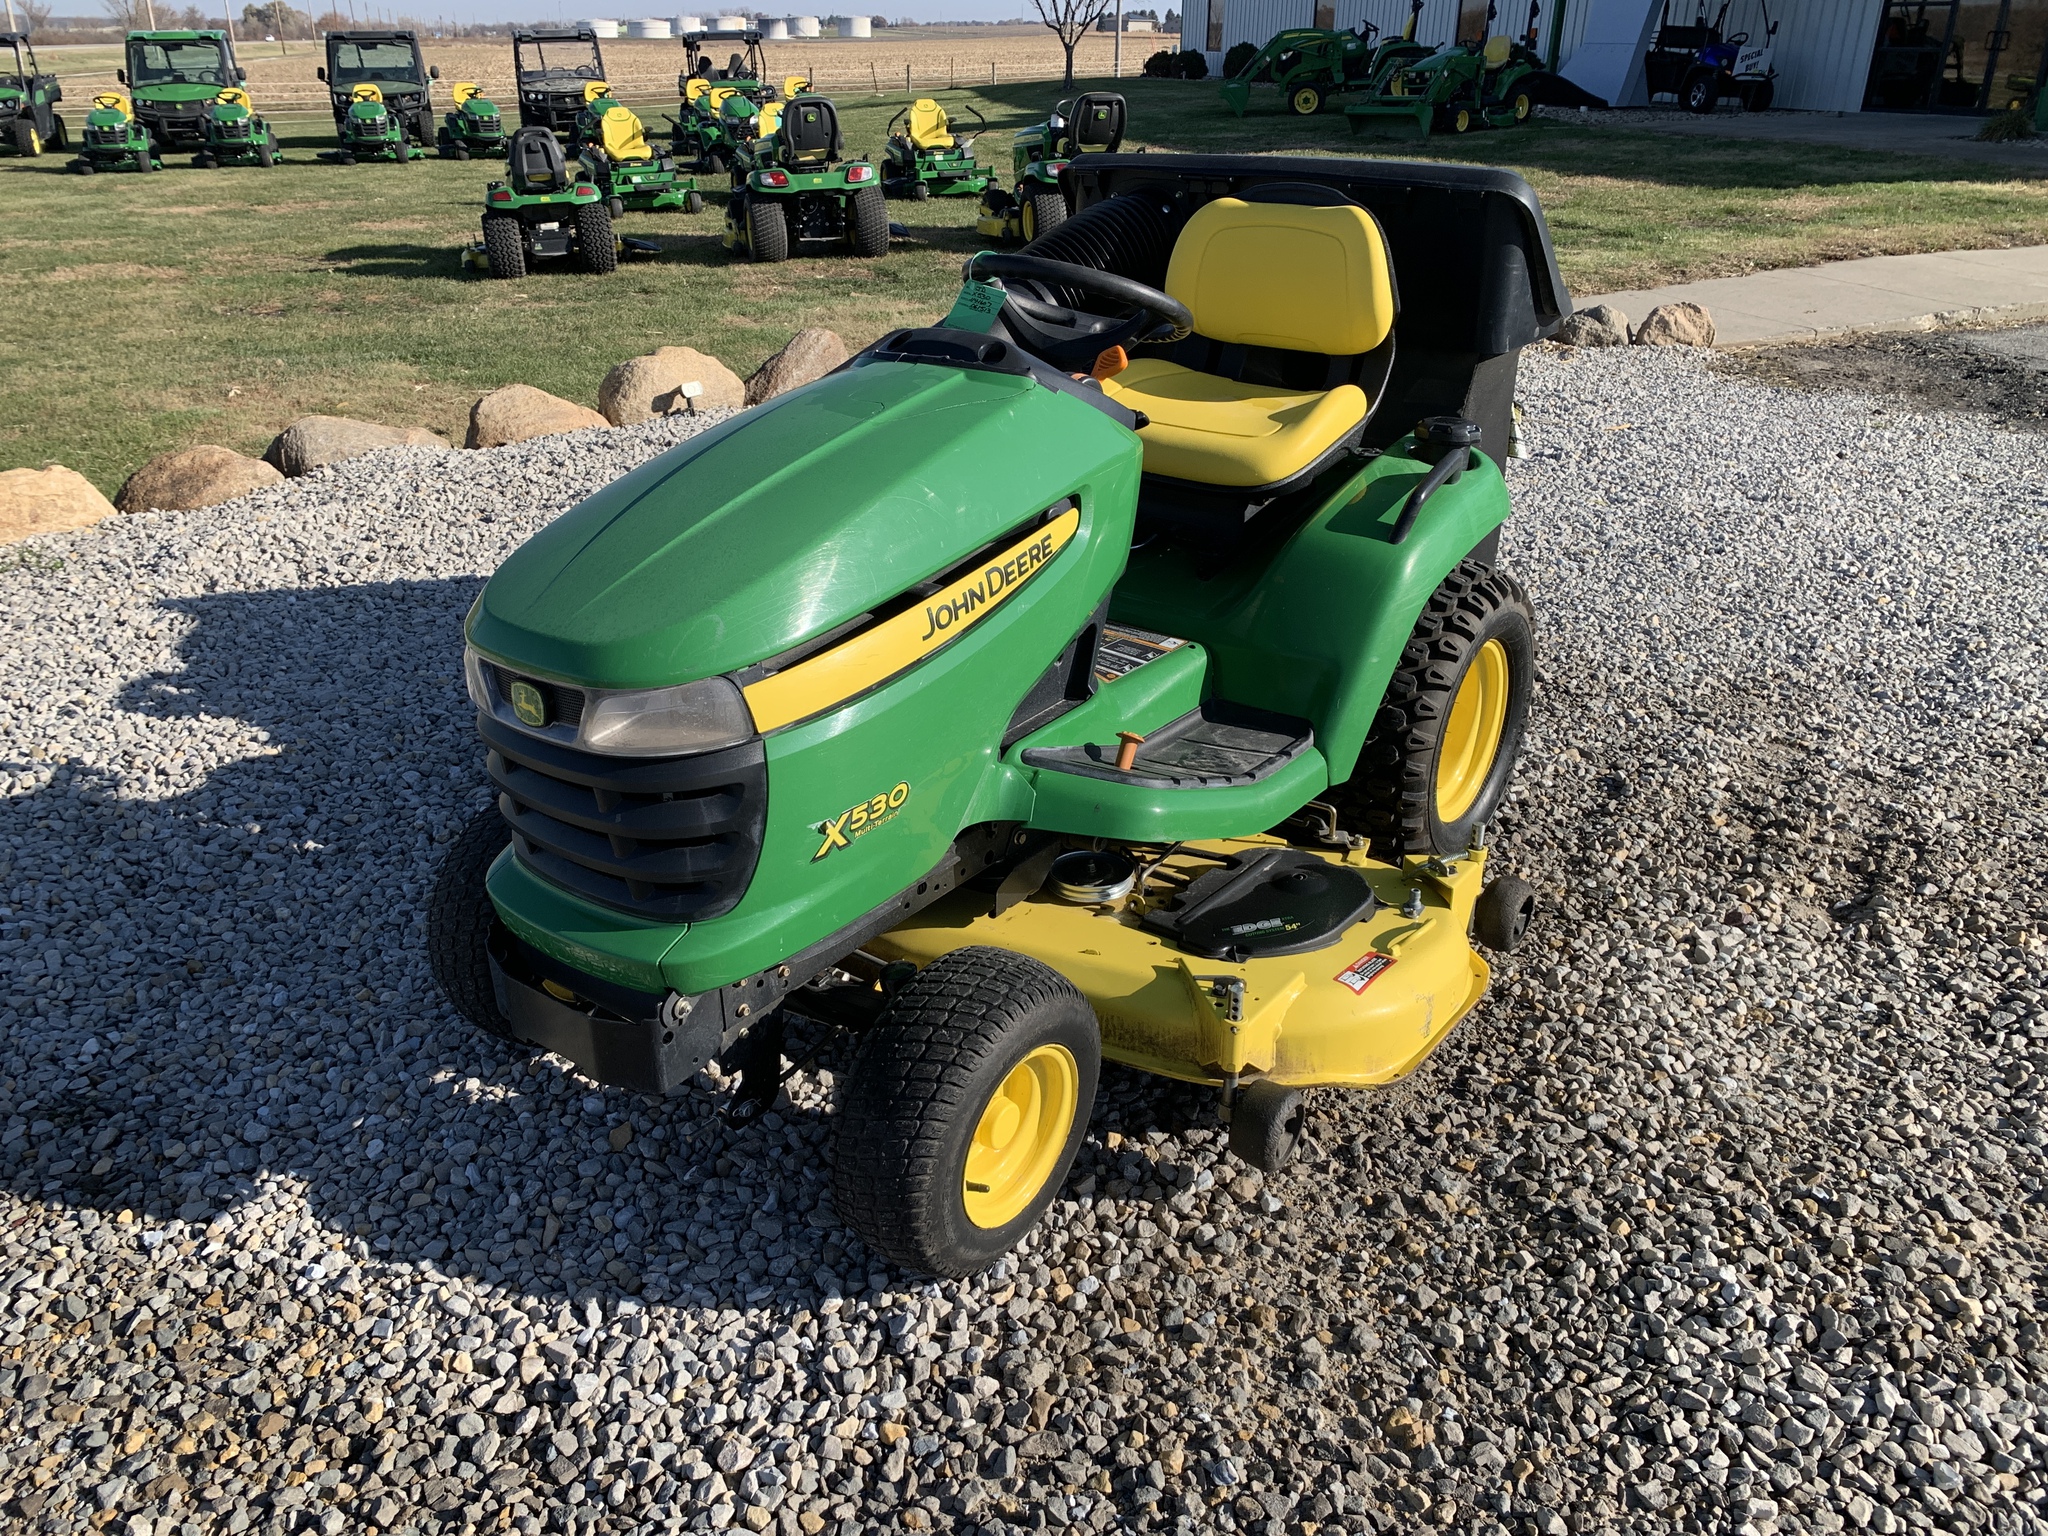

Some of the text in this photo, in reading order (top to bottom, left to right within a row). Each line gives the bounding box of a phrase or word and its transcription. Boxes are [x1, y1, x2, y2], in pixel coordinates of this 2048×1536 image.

[1740, 49, 1763, 63] SPECIAL
[1745, 61, 1760, 72] BUY!
[922, 533, 1053, 641] JOHN DEERE
[809, 781, 909, 864] X530
[854, 810, 899, 838] Multi-Terrain
[1230, 917, 1283, 935] EDGE
[1285, 922, 1301, 931] 54"
